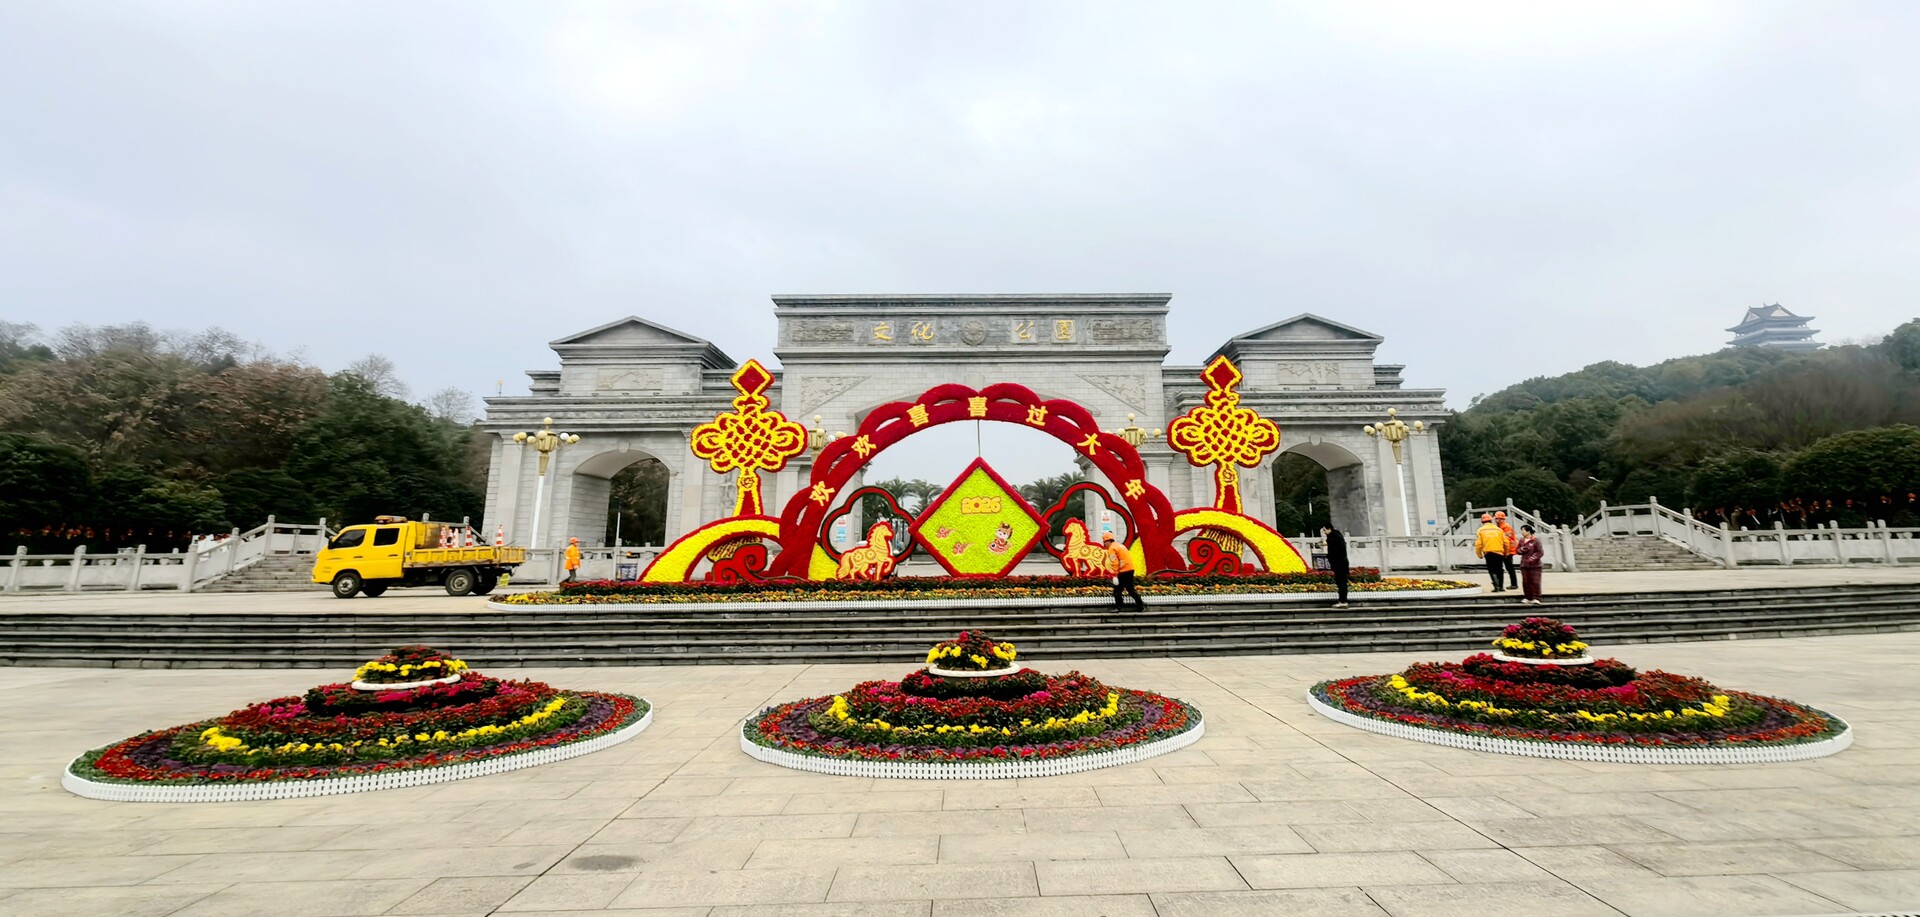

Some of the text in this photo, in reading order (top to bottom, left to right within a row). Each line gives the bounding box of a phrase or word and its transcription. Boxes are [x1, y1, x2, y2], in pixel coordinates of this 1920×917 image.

[809, 396, 1146, 506] 欢欢喜喜过大年
[961, 495, 1002, 514] 2026
